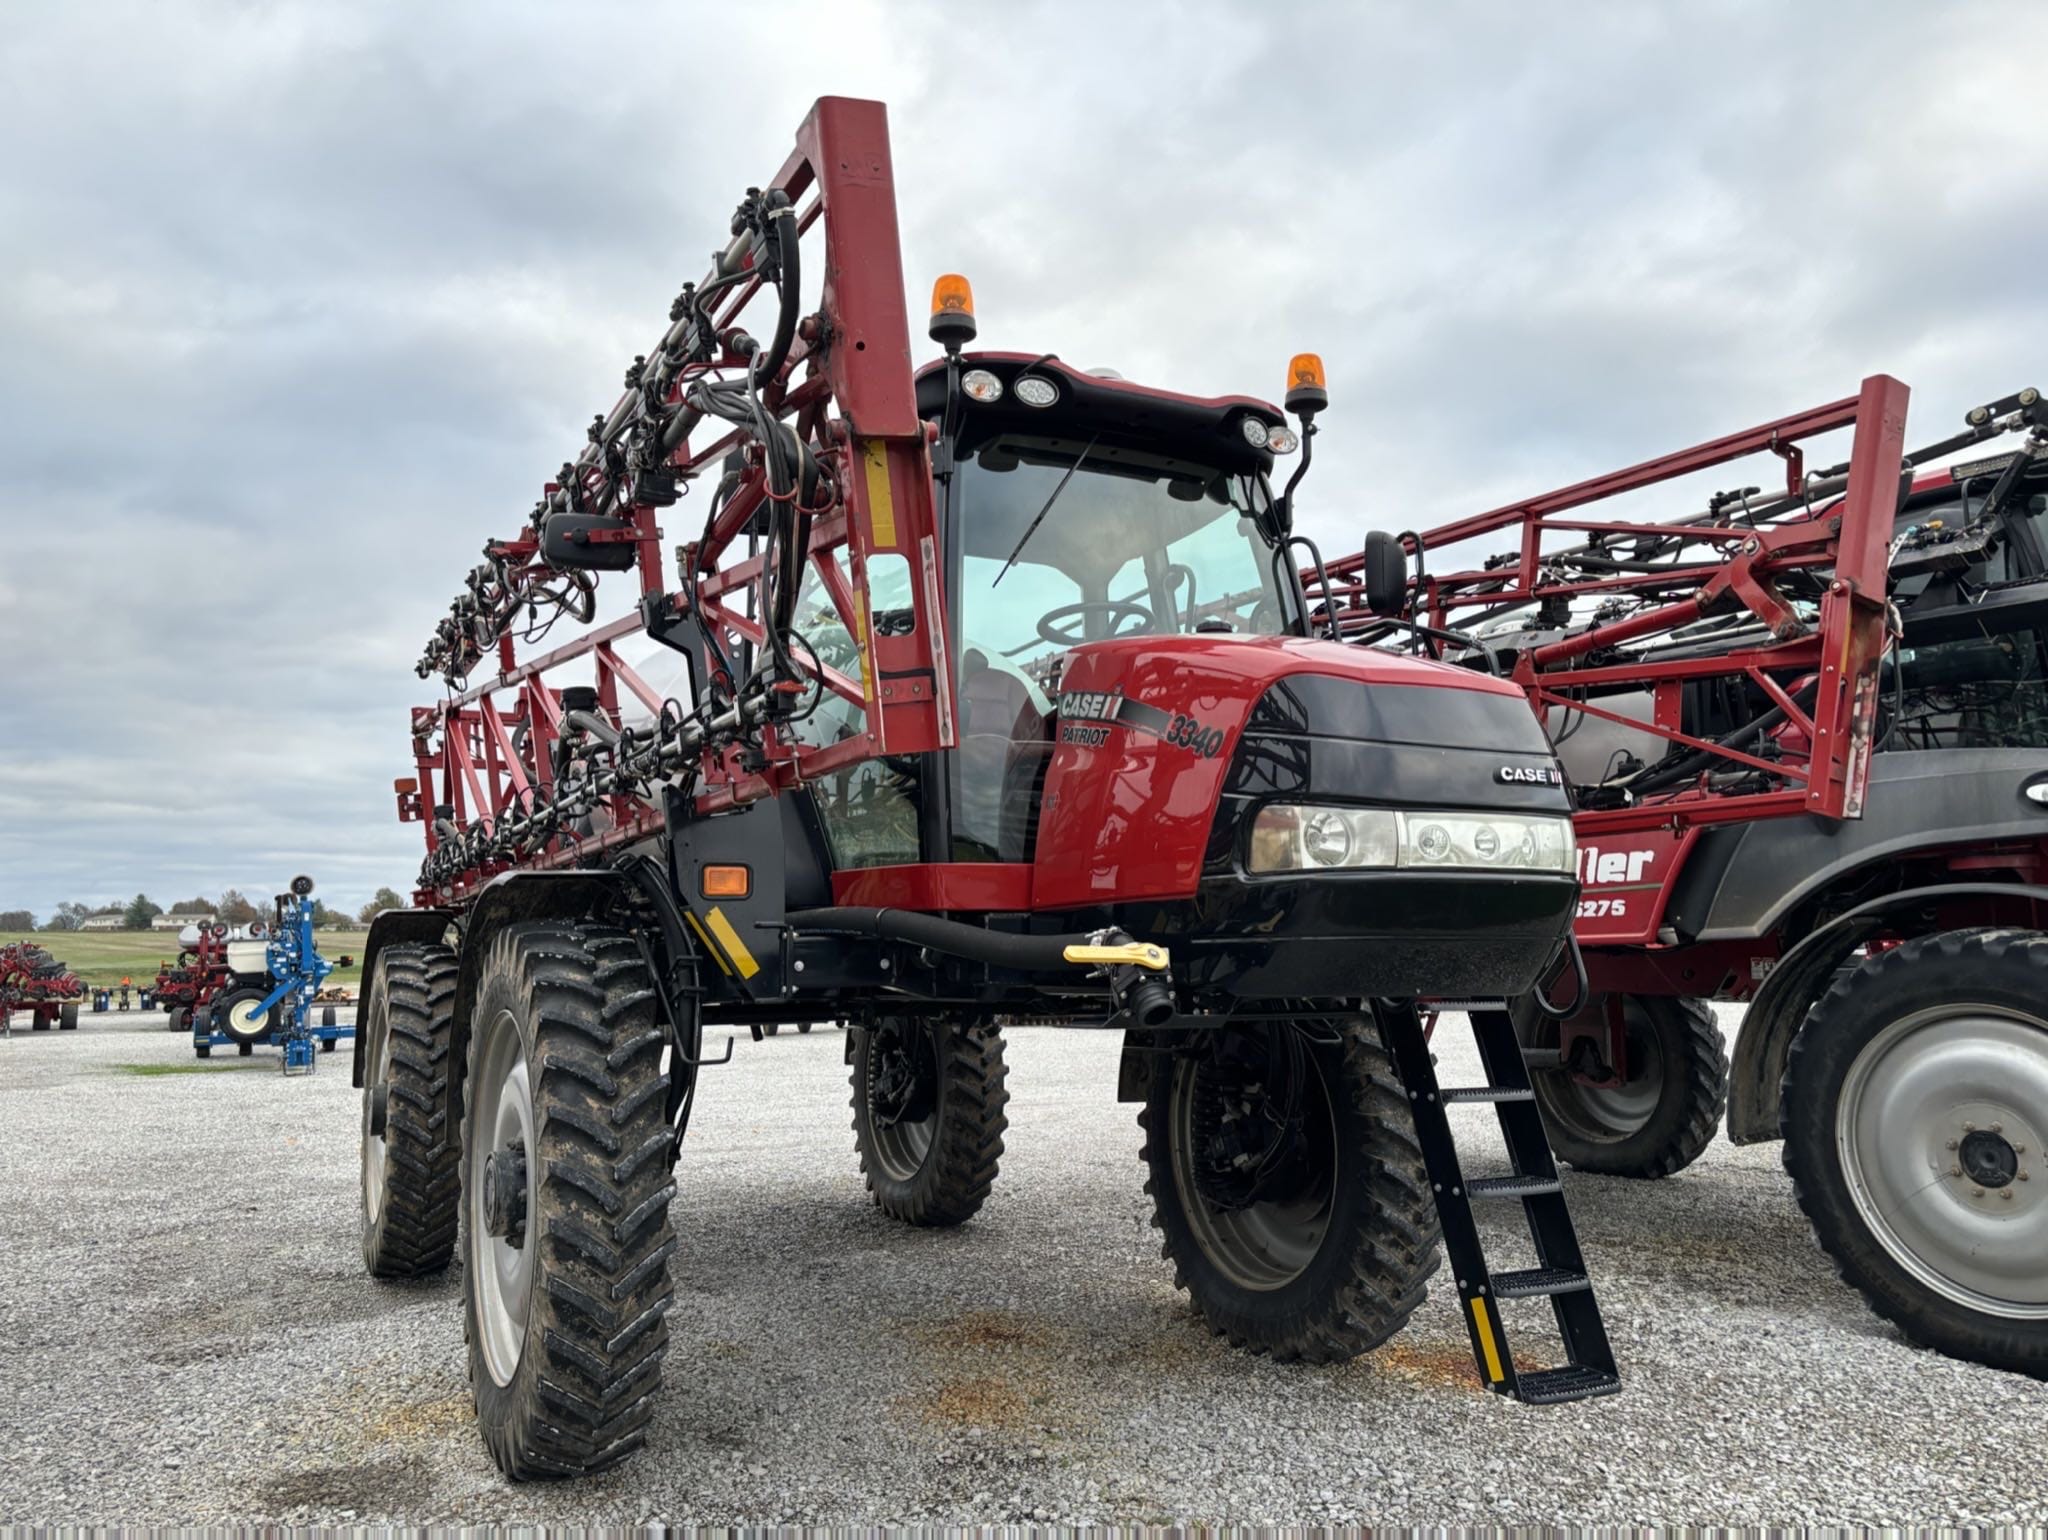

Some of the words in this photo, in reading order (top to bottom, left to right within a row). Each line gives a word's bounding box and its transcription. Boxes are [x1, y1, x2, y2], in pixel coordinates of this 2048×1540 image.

[1061, 693, 1103, 719] CASE
[1061, 726, 1111, 747] PATRIOT
[1167, 714, 1224, 759] 3340
[1500, 766, 1547, 782] CASE
